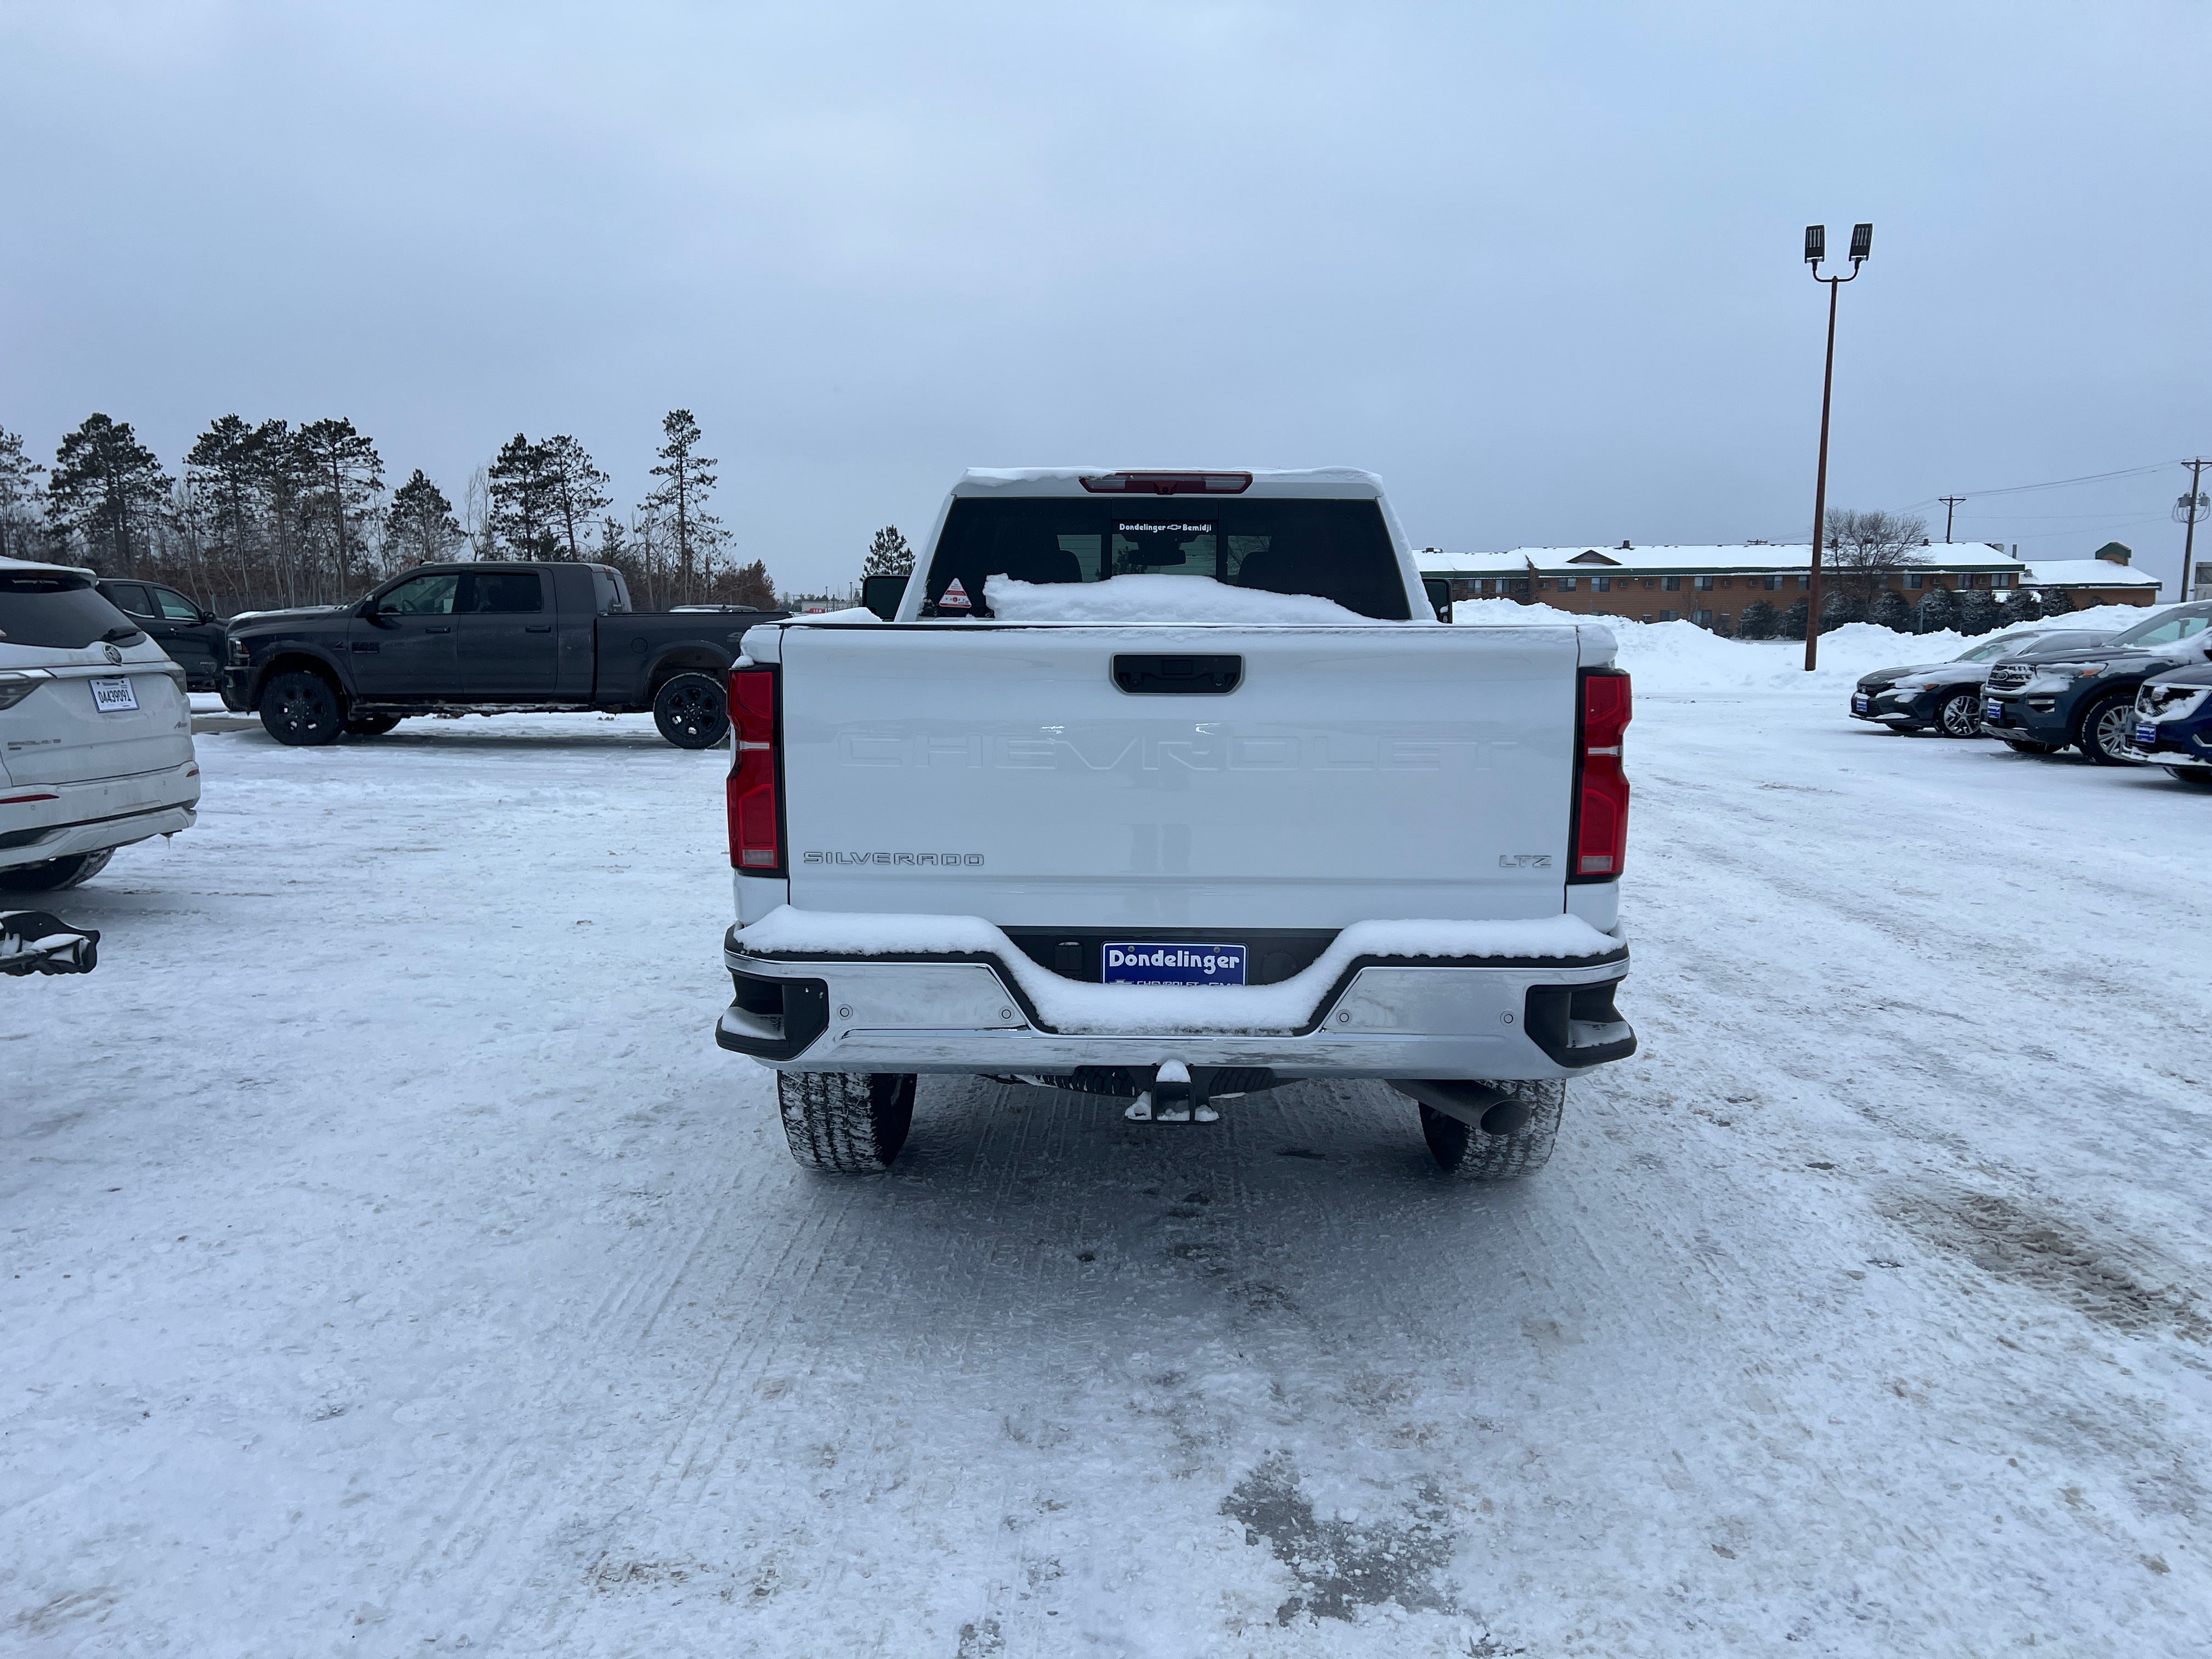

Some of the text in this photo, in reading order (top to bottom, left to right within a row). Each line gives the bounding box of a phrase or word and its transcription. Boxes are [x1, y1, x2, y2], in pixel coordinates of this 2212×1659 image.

[1119, 523, 1211, 533] Dondelinger Bemidji
[837, 732, 1519, 771] CHEVROLET
[804, 851, 984, 866] SILVERADO
[1499, 855, 1551, 867] LTZ
[1109, 950, 1239, 974] Dondelinger
